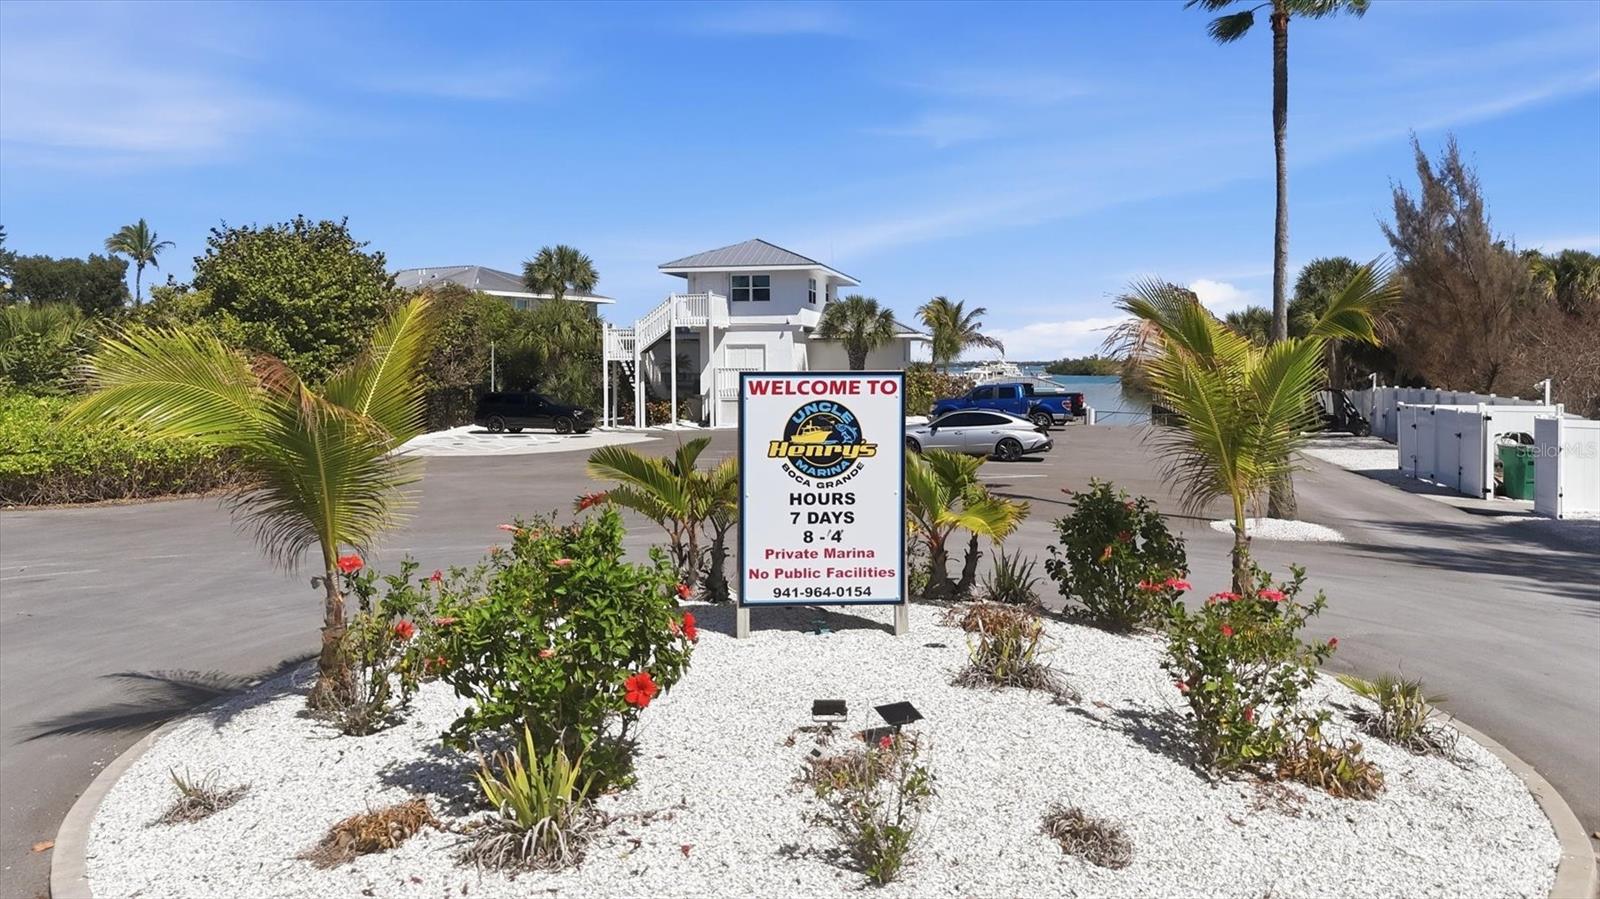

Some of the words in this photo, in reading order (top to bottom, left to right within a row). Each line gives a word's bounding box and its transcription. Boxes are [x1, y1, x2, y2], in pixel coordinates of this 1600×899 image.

[748, 380, 861, 395] WELCOME
[867, 380, 898, 395] TO
[792, 402, 854, 424] UNCLE
[767, 439, 878, 459] Henry's
[795, 459, 850, 477] MARINA
[782, 463, 811, 487] BOCA
[816, 462, 865, 489] GRANDE
[789, 492, 856, 505] HOURS
[790, 512, 801, 524] 7
[807, 511, 855, 524] DAYS
[803, 530, 814, 543] 8
[830, 530, 842, 543] 4
[765, 548, 819, 560] Private
[824, 547, 875, 559] Marina
[748, 568, 769, 579] No
[774, 567, 821, 579] Public
[826, 566, 896, 578] Facilities
[773, 586, 872, 599] 941-964-0154
